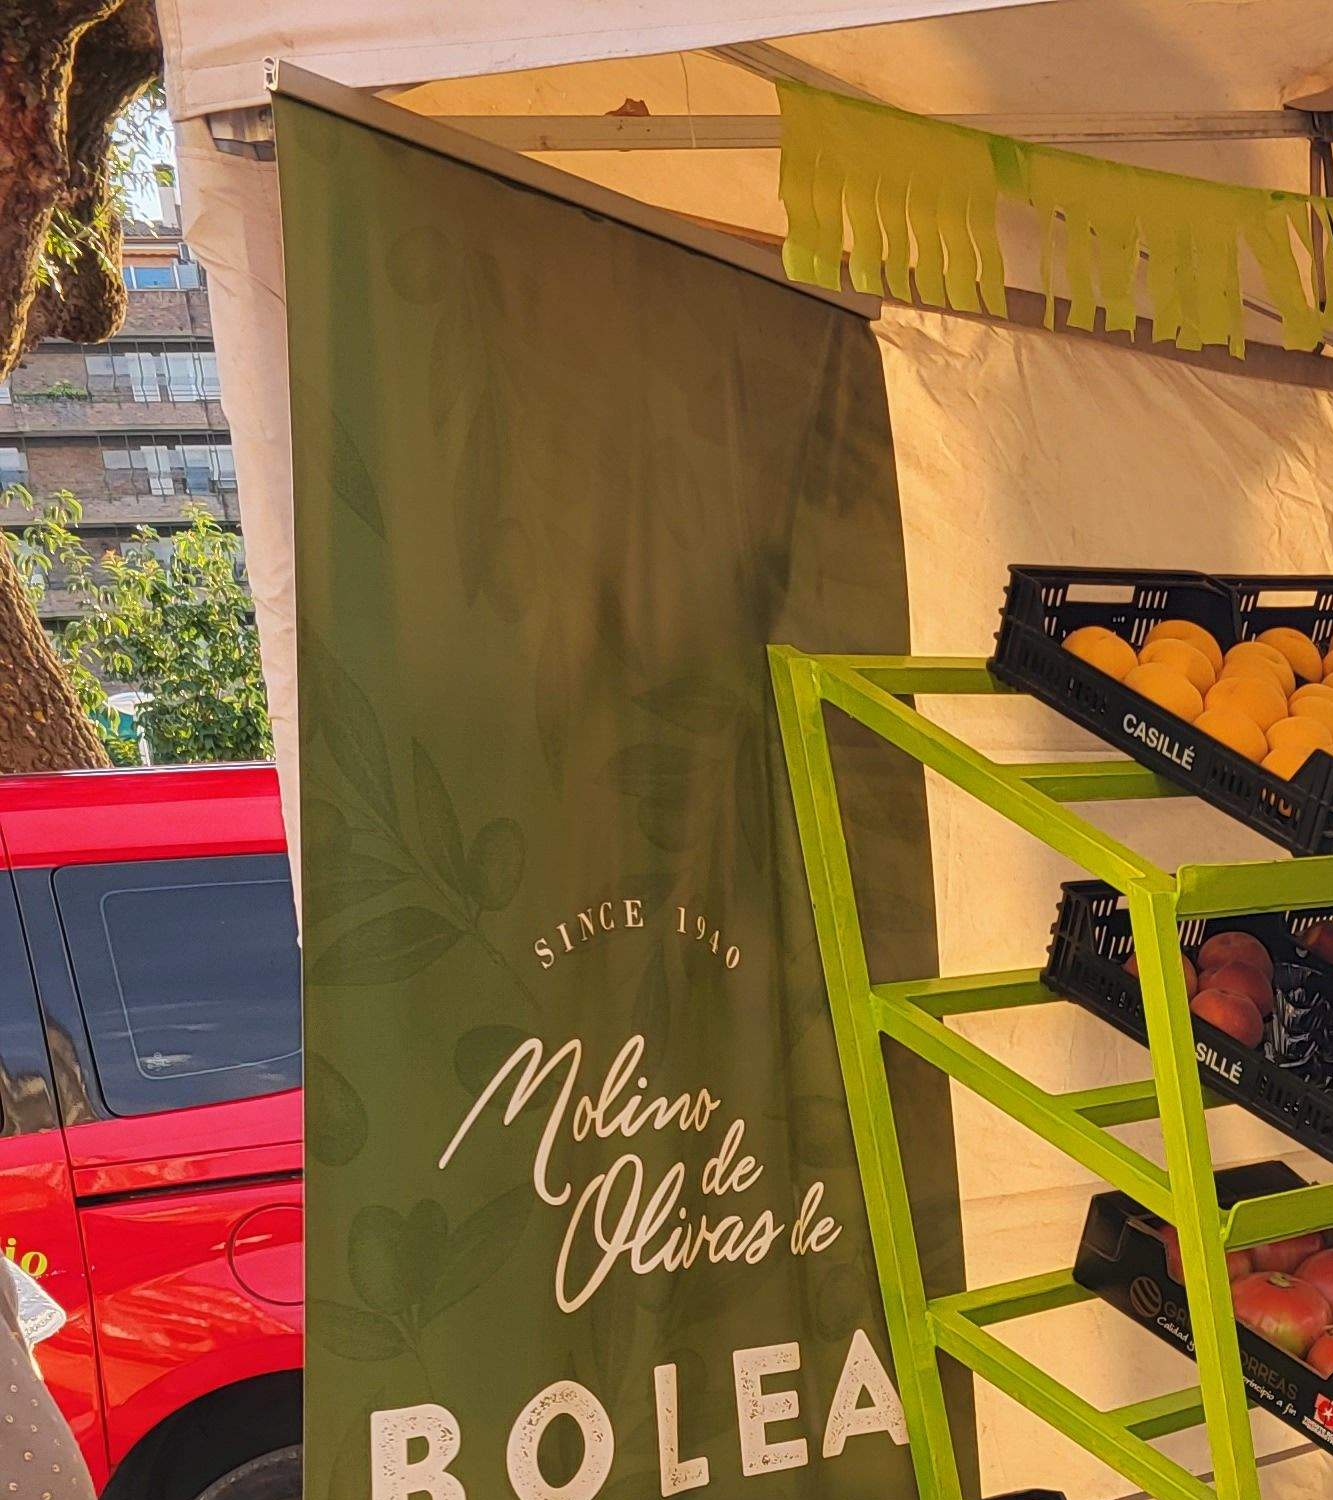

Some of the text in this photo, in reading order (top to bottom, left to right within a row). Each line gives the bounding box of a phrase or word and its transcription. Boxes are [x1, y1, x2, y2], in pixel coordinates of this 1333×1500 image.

[1122, 713, 1196, 772] CASILLÉ
[534, 899, 741, 970] SINCE 1940
[1195, 1042, 1244, 1086] SILLÉ
[438, 1035, 721, 1206] Molino
[700, 1118, 764, 1196] de
[554, 1152, 843, 1314] Olivas de
[1240, 1350, 1300, 1400] ORREAS
